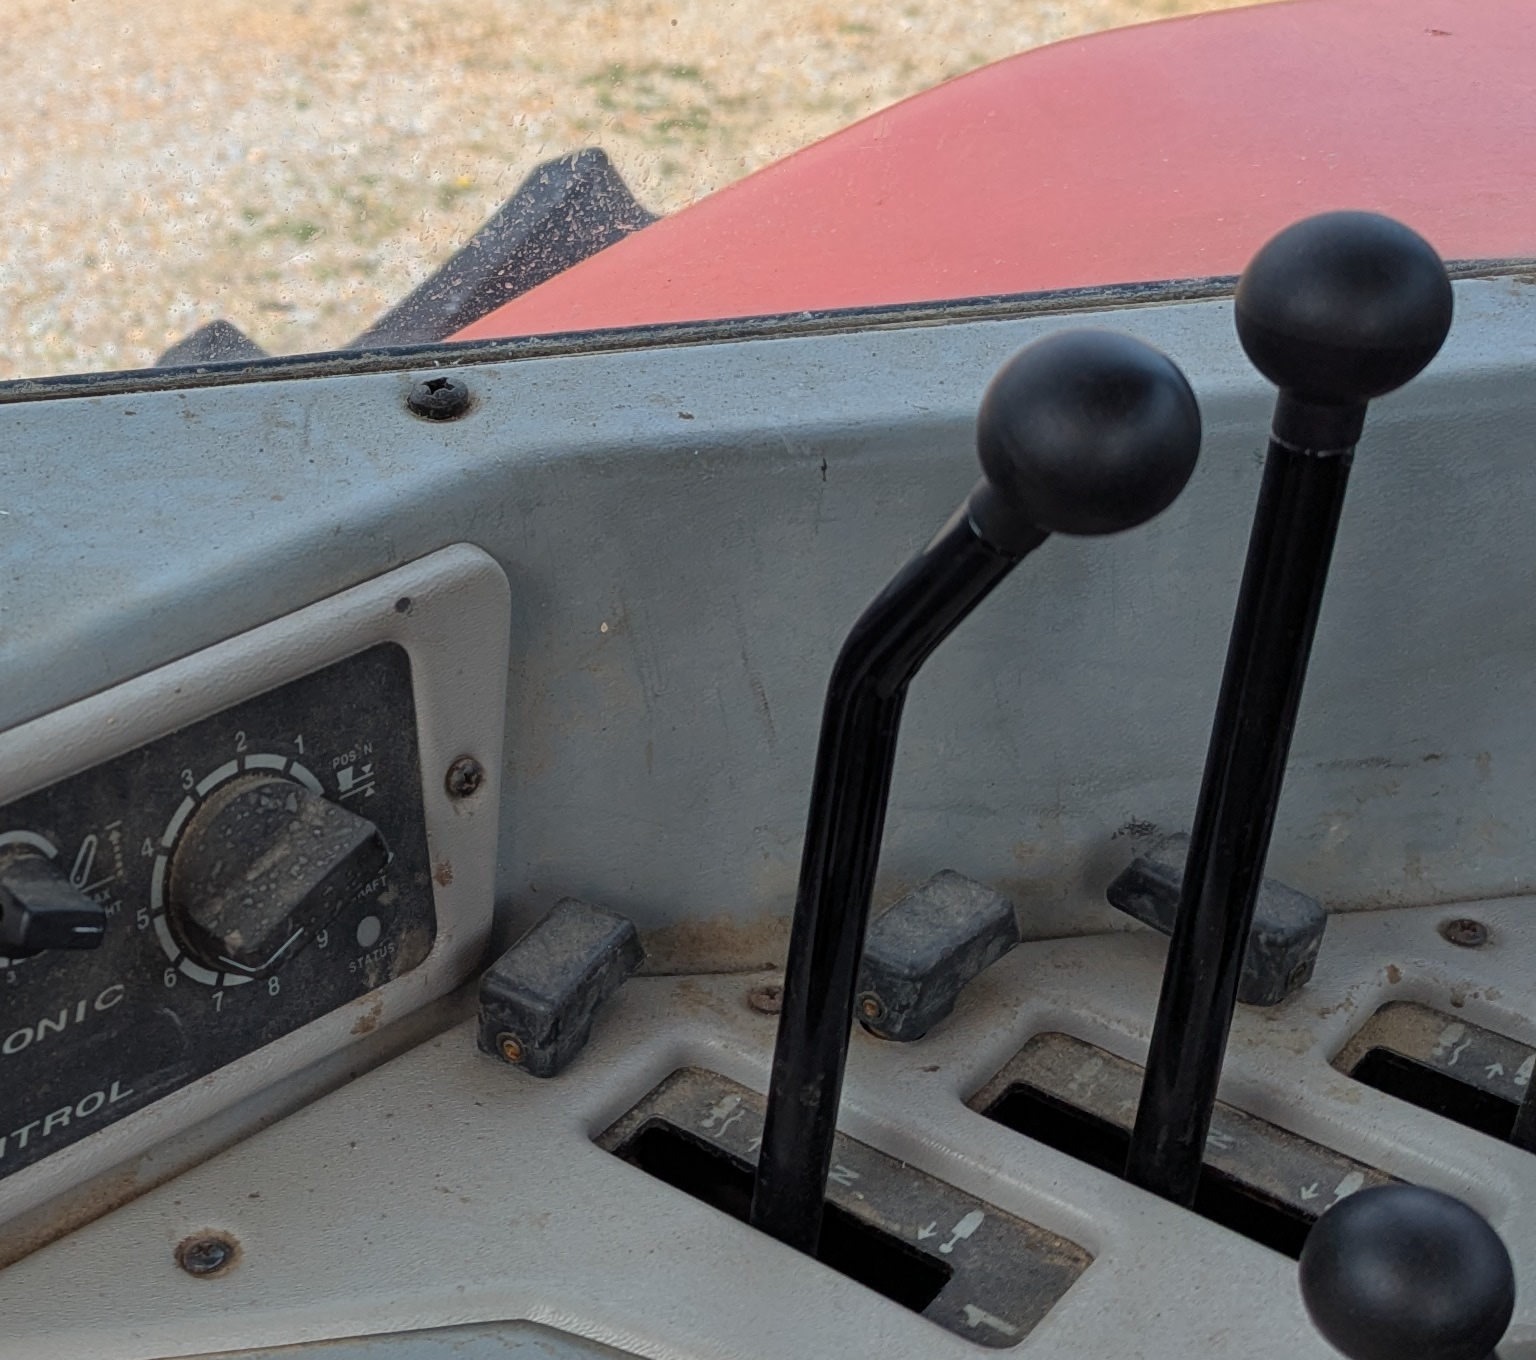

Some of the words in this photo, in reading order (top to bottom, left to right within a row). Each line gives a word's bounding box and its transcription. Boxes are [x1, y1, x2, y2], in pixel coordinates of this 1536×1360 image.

[234, 731, 247, 753] 2
[294, 734, 305, 755] 1
[181, 769, 194, 790] 3
[141, 838, 155, 858] 4
[136, 907, 150, 929] 5
[349, 942, 395, 973] STATUS
[6, 970, 16, 984] 3
[164, 967, 177, 988] 6
[268, 975, 280, 996] 8
[212, 990, 224, 1012] 7
